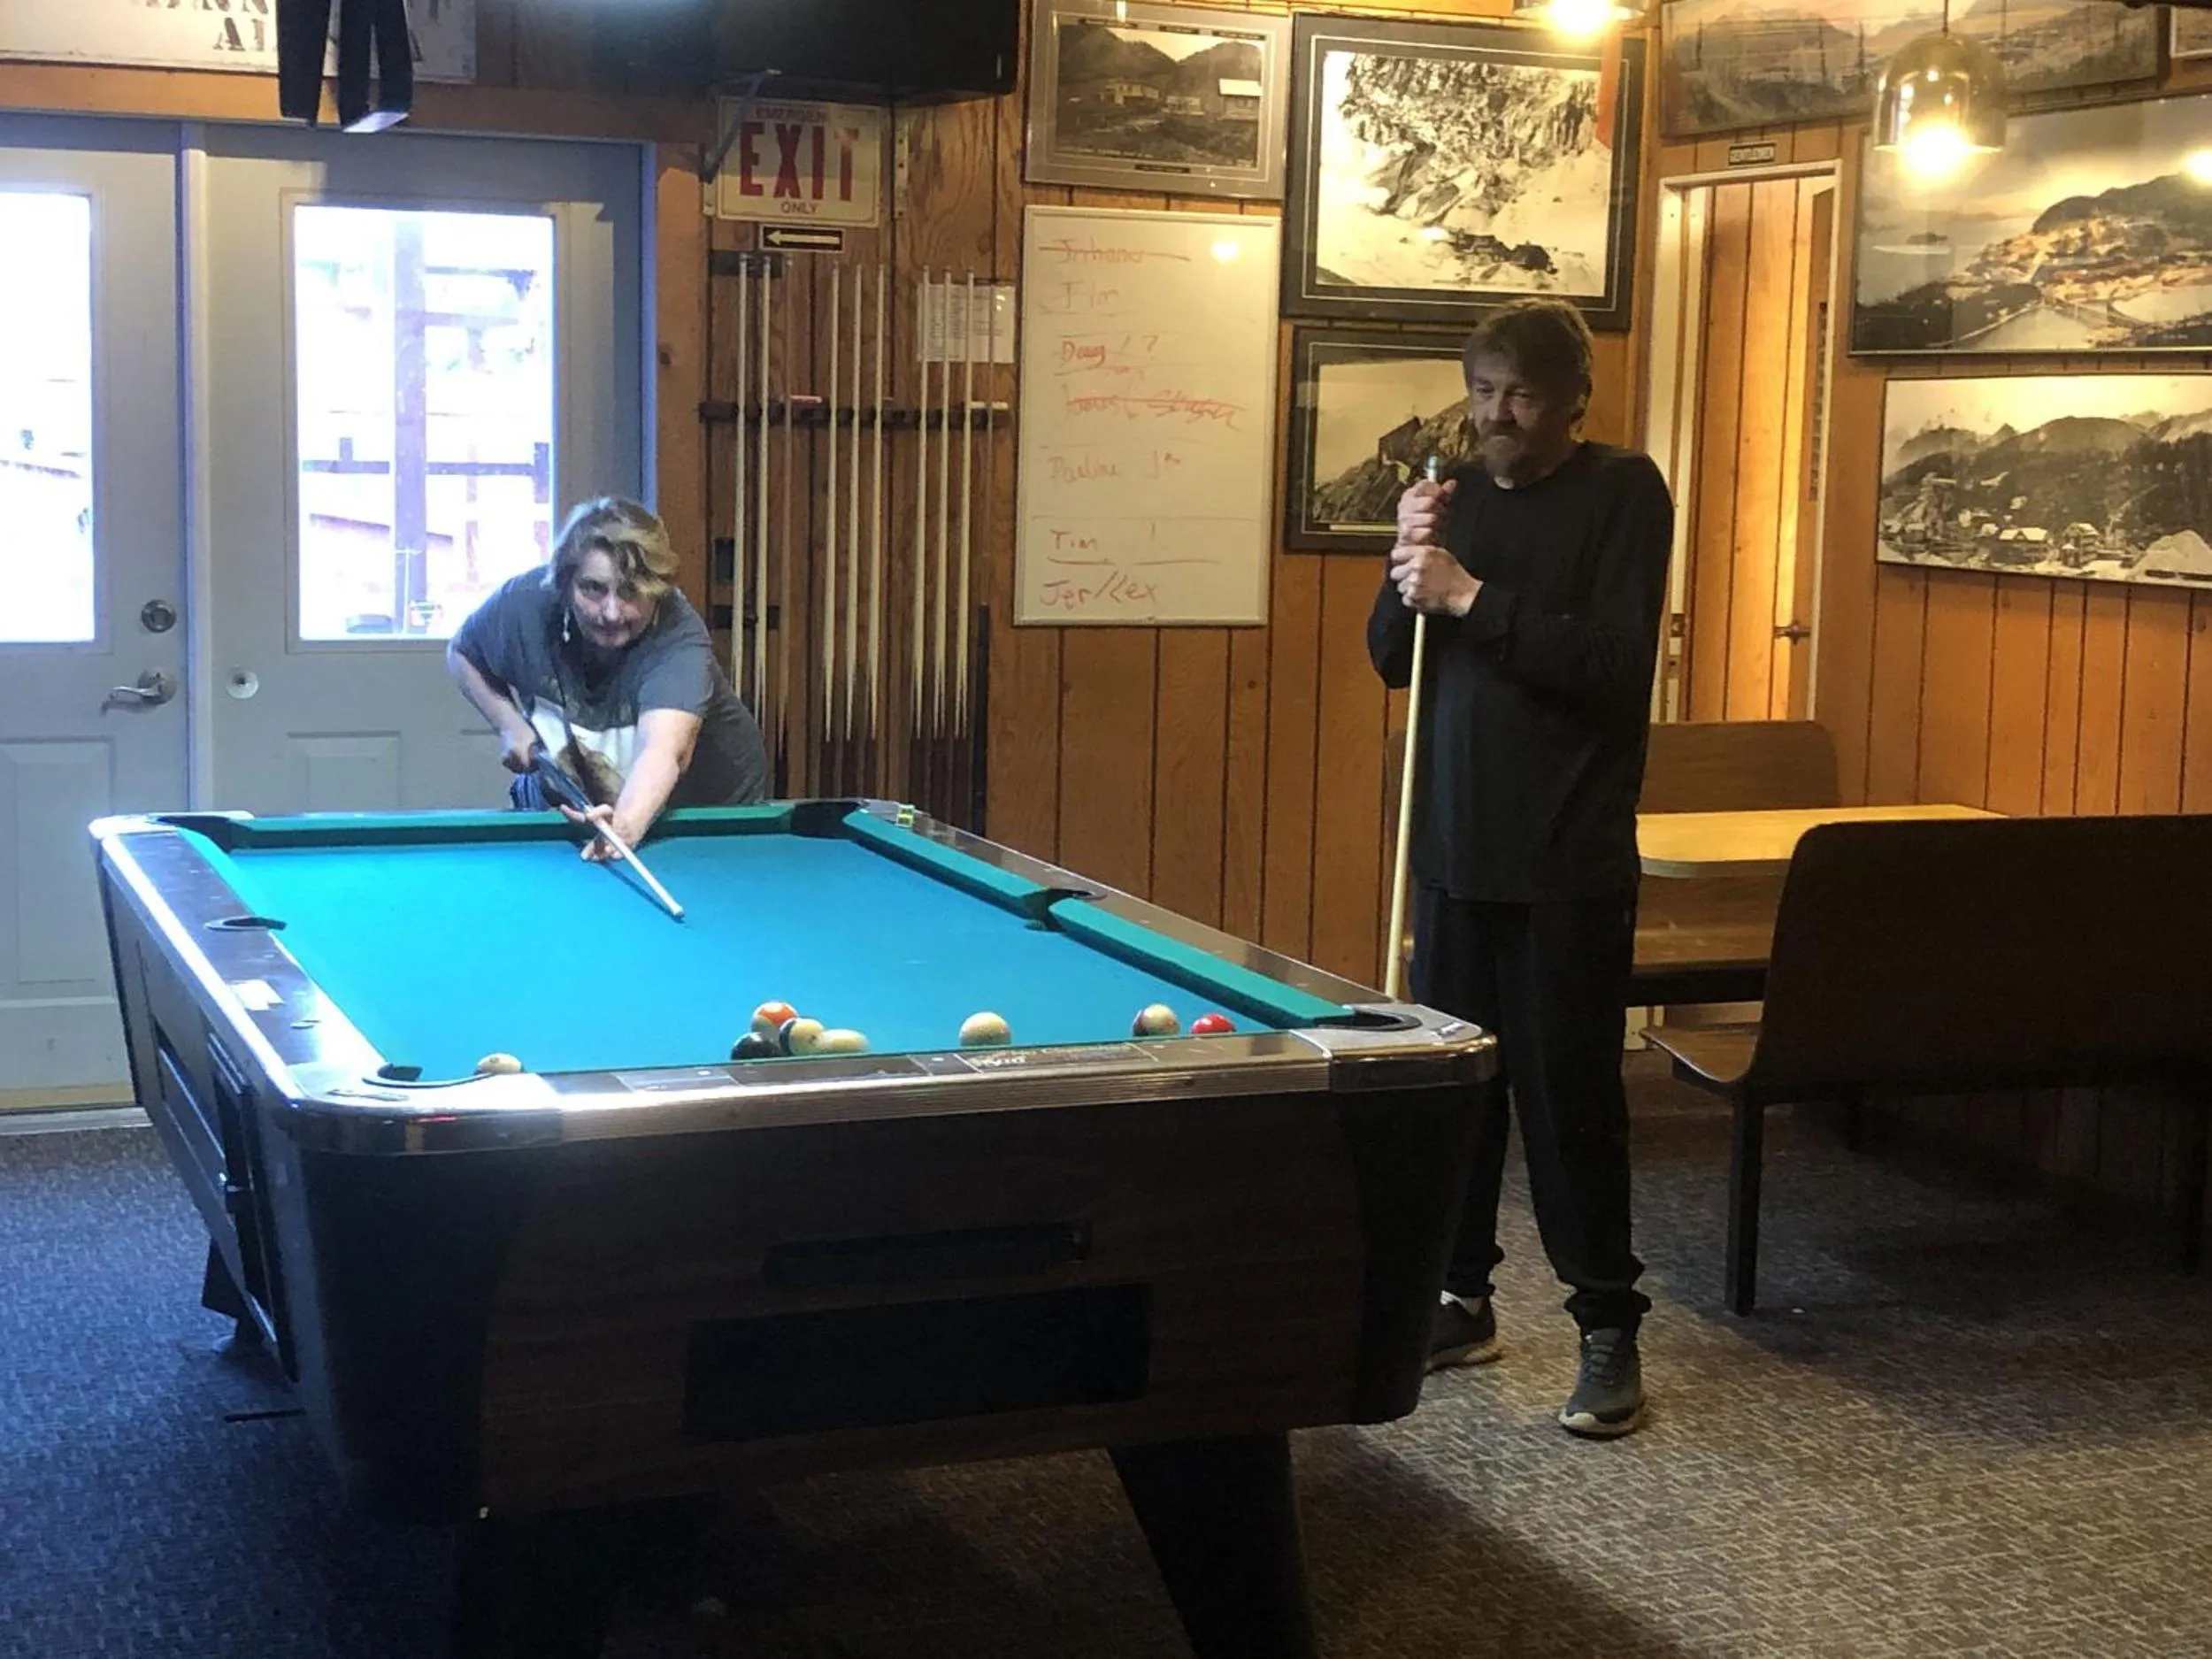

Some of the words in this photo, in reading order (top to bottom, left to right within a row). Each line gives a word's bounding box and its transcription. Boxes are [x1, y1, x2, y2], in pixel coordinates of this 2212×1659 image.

[740, 121, 859, 202] EXIT
[780, 201, 818, 215] ONLY
[1049, 528, 1099, 550] Tim
